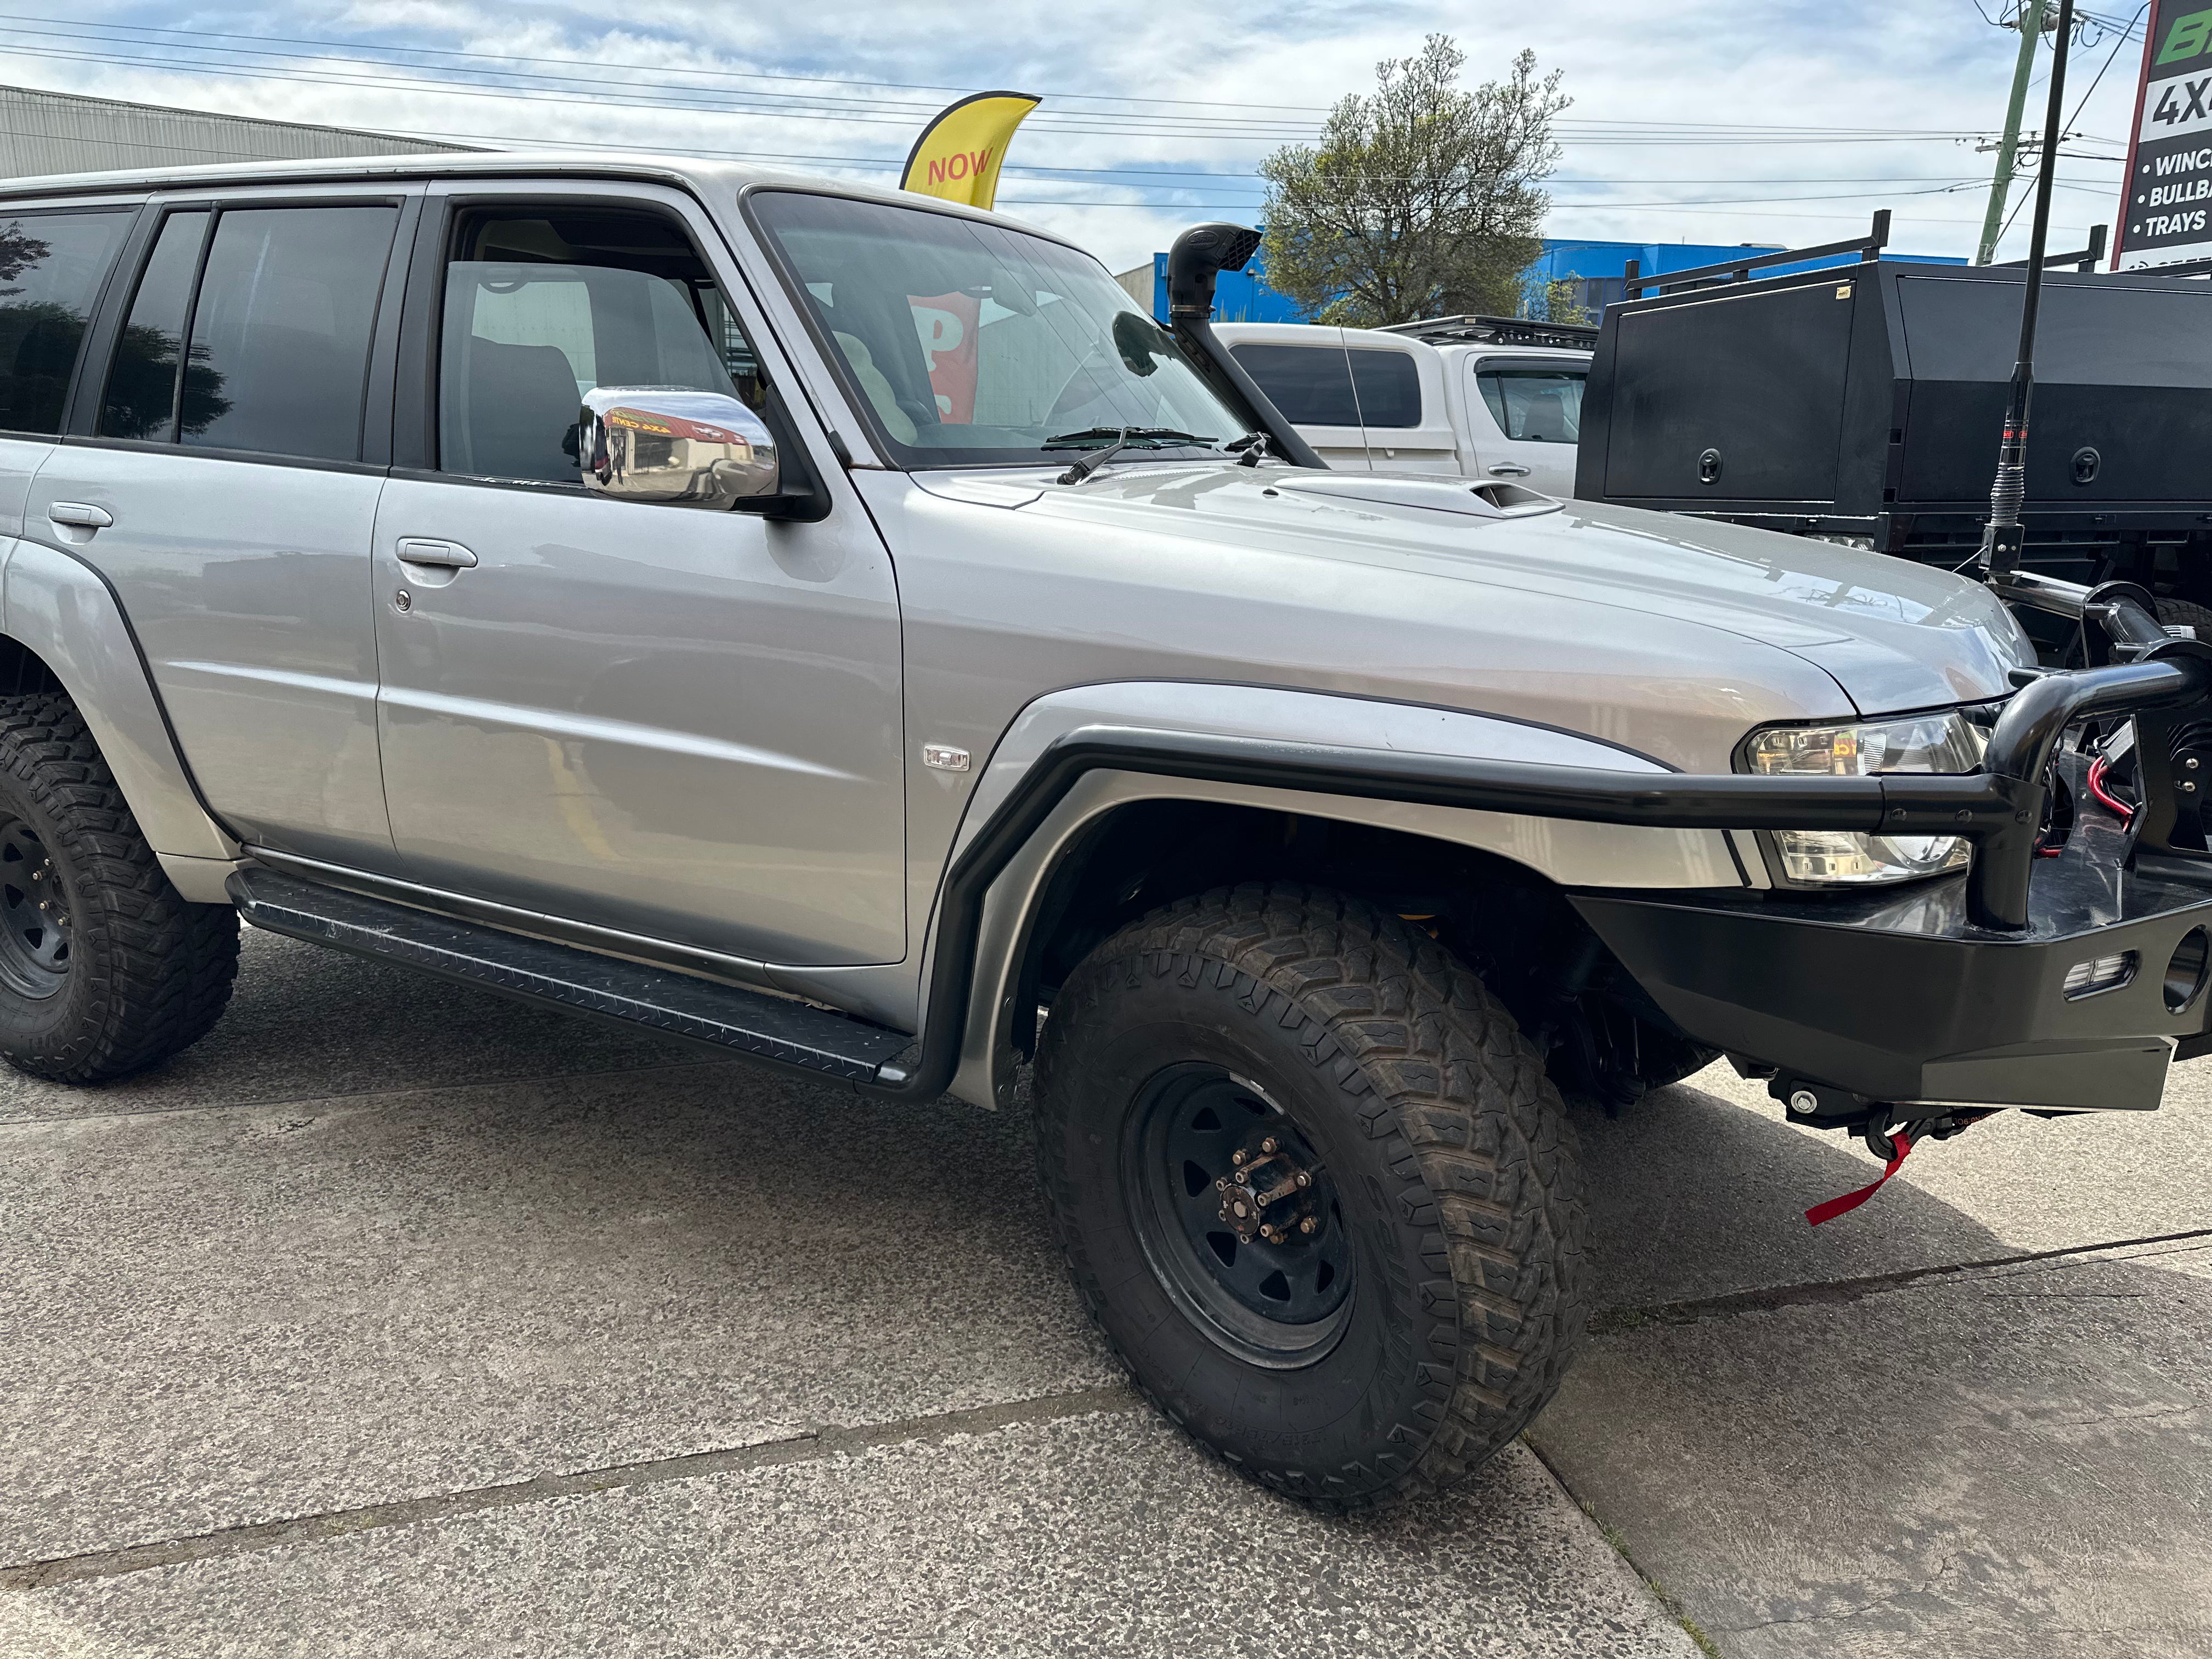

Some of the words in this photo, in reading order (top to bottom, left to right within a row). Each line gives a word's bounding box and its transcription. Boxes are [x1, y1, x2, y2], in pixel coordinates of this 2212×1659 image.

[2155, 9, 2212, 66] B
[2152, 77, 2212, 126] 4X
[928, 147, 994, 186] NOW
[2155, 148, 2212, 177] WINC
[2146, 210, 2207, 237] TRAYS
